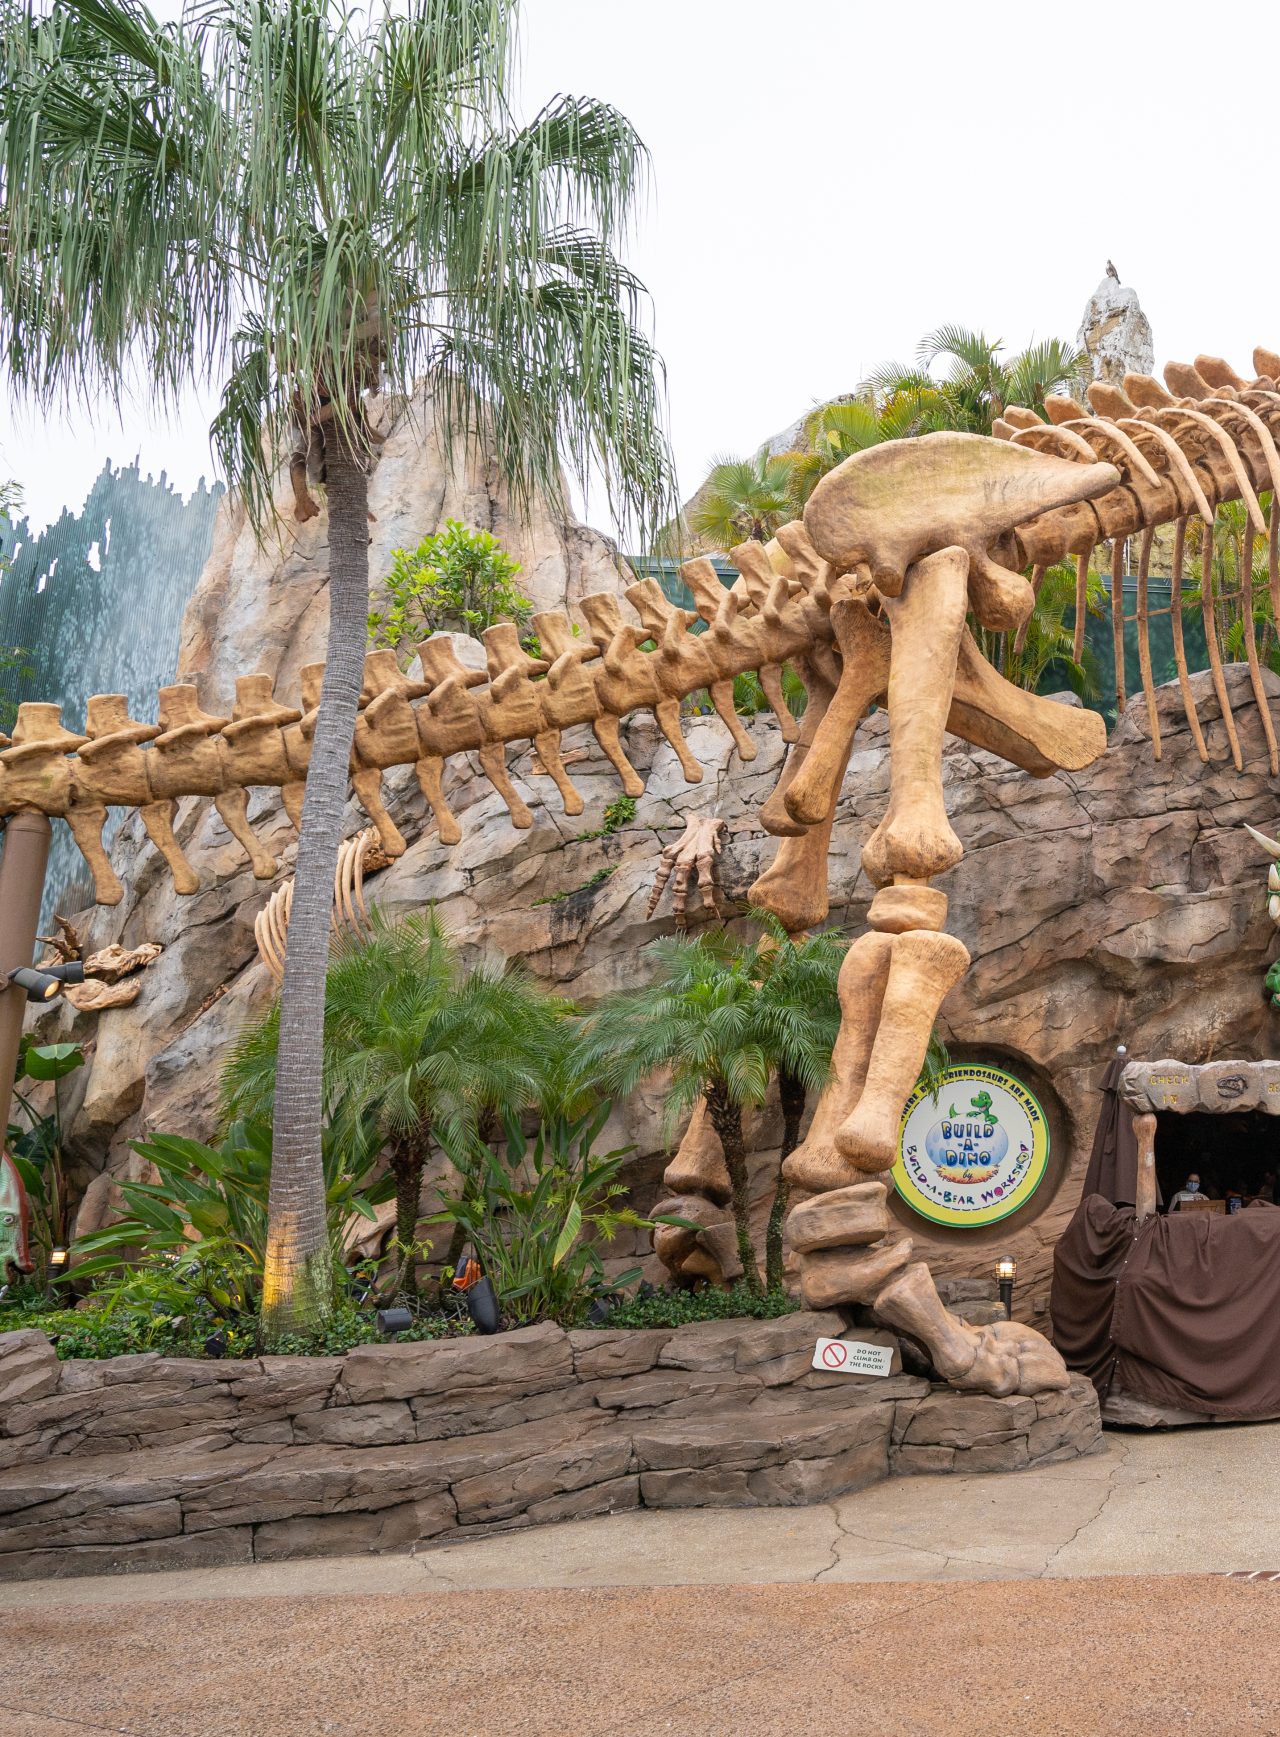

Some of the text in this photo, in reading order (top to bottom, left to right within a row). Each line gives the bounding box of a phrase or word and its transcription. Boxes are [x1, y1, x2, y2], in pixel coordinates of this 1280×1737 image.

[1150, 1075, 1189, 1086] CHECK
[1009, 1083, 1025, 1099] ARE
[1023, 1098, 1040, 1122] MADE
[941, 1121, 994, 1140] BUILD
[946, 1150, 991, 1166] DINO
[906, 1145, 975, 1205] BUILD-A-BEAR
[962, 1169, 973, 1181] by
